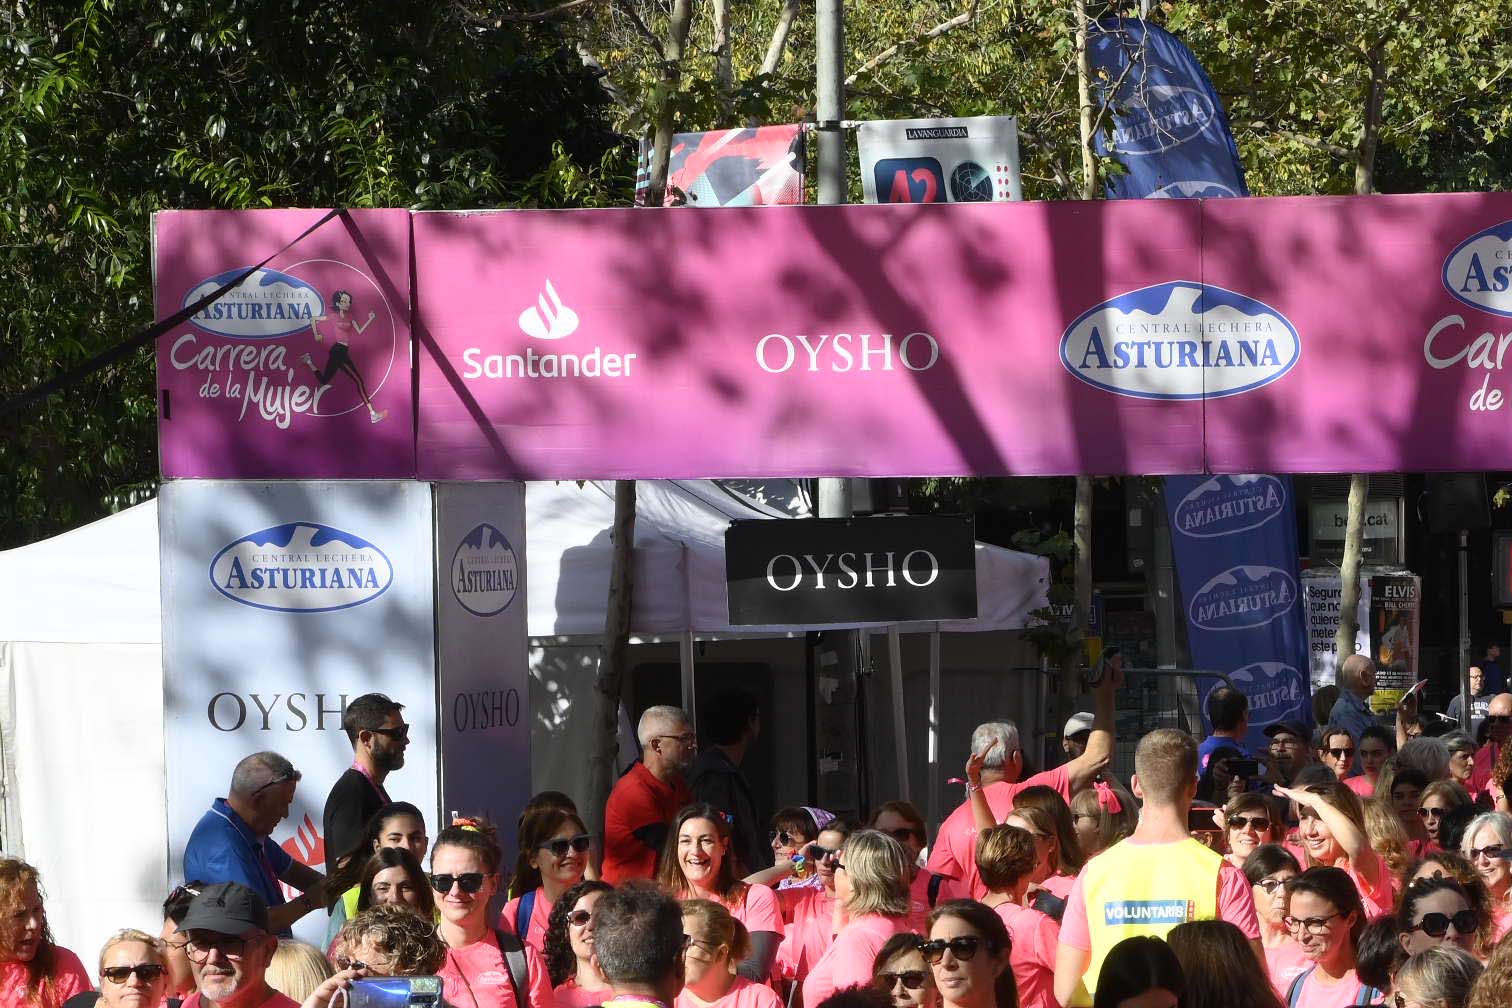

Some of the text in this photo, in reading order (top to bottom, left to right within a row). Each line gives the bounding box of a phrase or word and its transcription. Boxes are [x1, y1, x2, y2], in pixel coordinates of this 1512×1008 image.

[1115, 322, 1191, 334] CENTRAL
[170, 333, 288, 371] Carrera
[463, 346, 637, 380] Santander
[755, 331, 941, 374] OYSHO
[1079, 326, 1281, 371] ASTURIANA
[199, 369, 334, 430] de la Mujer
[1470, 375, 1503, 412] de
[224, 555, 380, 589] ASTURIANA
[251, 553, 374, 564] CENTRAL LECHERA
[456, 557, 515, 593] ASTURIANA
[766, 549, 940, 591] OYSHO
[1384, 585, 1416, 598] ELVIS
[207, 691, 387, 732] OYSH
[454, 688, 520, 732] OYSHO
[1105, 906, 1184, 919] VOLUNTARIS
